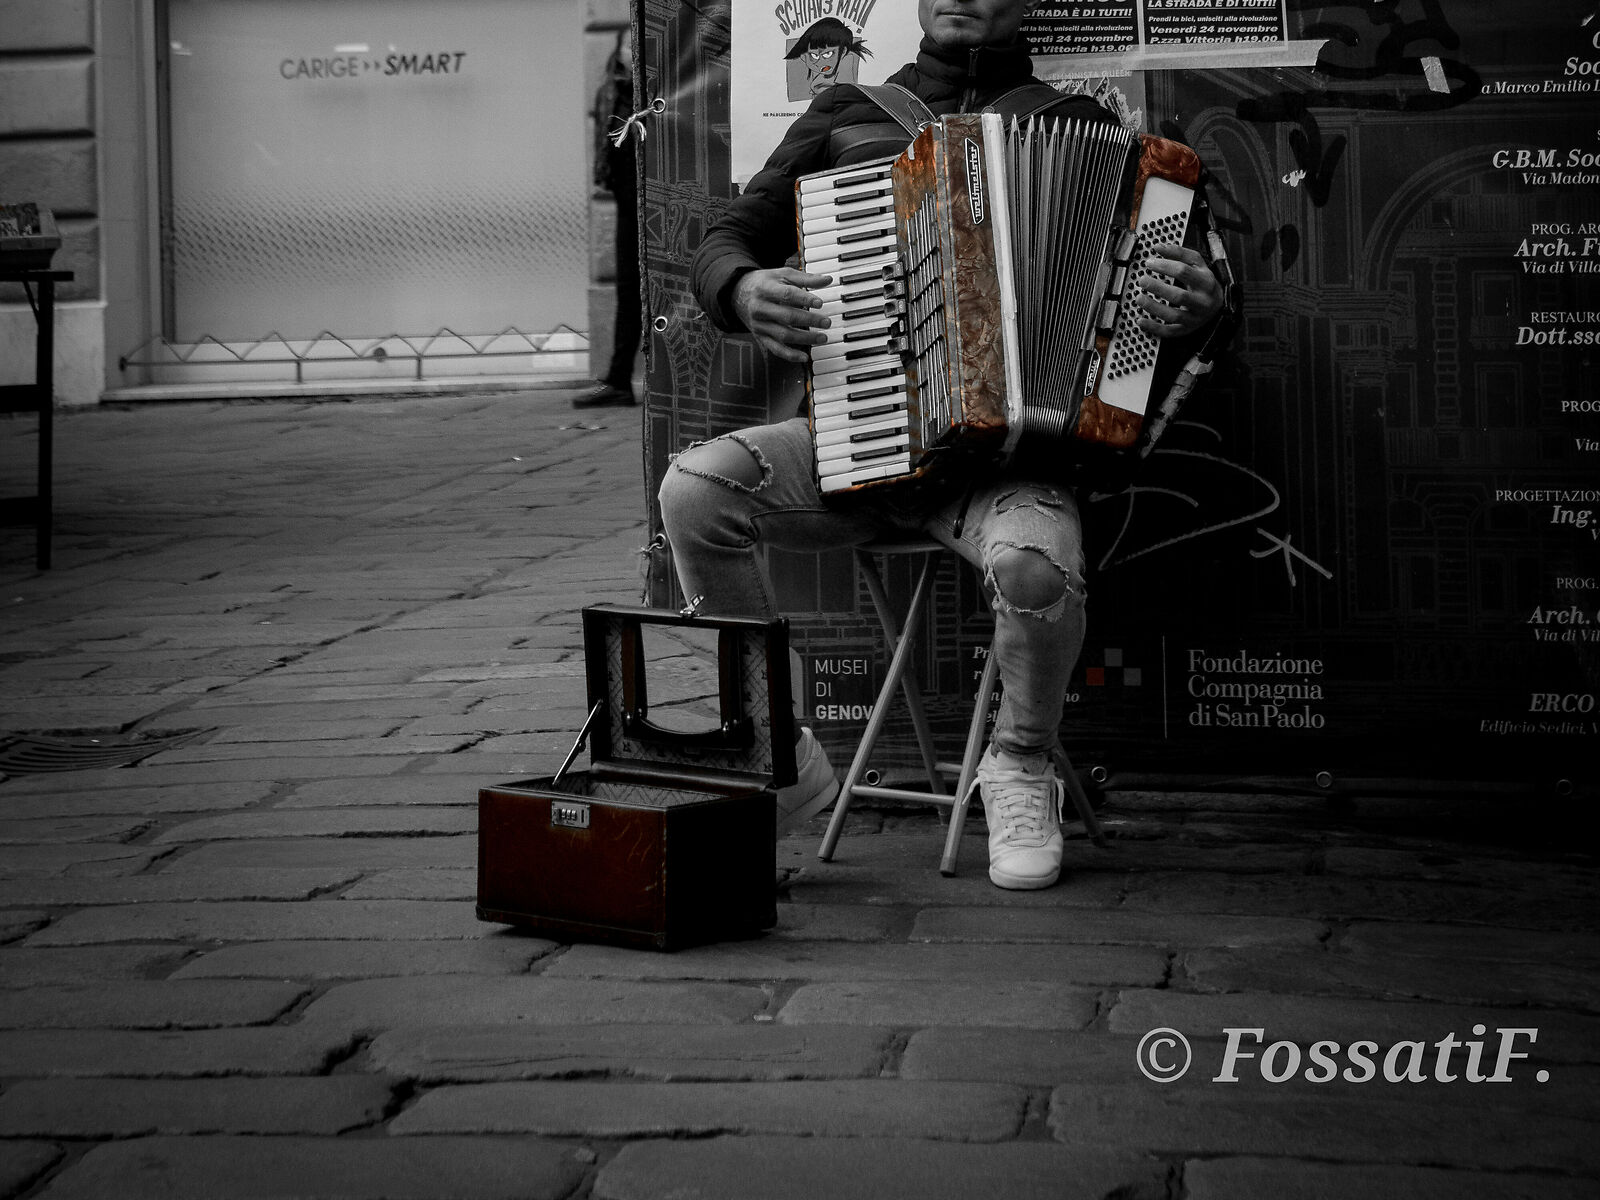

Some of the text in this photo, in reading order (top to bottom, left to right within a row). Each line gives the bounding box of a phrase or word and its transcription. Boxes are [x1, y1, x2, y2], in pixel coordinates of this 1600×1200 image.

[1147, 0, 1162, 8] LA
[1165, 0, 1212, 8] STRADA
[1226, 0, 1239, 7] DI
[1082, 8, 1096, 17] DI
[1098, 8, 1133, 17] TUTTI!
[1150, 24, 1279, 34] Venerdì 24 novembre
[1055, 34, 1134, 43] 24 novembre
[1150, 35, 1278, 44] P.zza Vittoria h19.00
[1042, 45, 1088, 54] Vittoria
[280, 52, 467, 80] CARIGE SMART
[1493, 81, 1541, 94] Marco
[1542, 79, 1592, 93] Emilio
[1492, 149, 1562, 169] G.B.M.
[1521, 172, 1546, 185] Via
[1531, 223, 1574, 235] PROG.
[1513, 238, 1576, 257] Arch.
[1521, 261, 1546, 274] Via
[1549, 261, 1564, 274] di
[1575, 438, 1600, 451] Via
[1550, 505, 1598, 528] Ing.
[1556, 577, 1600, 589] PROG.
[1528, 605, 1592, 625] Arch.
[1534, 628, 1576, 642] Via di
[815, 659, 869, 675] MUSEI
[1187, 649, 1324, 675] Fondazione
[815, 682, 832, 698] DI
[1188, 674, 1324, 706] Compagnia
[1527, 693, 1596, 713] ERCO
[1189, 703, 1212, 726] di
[1261, 705, 1325, 728] Paolo
